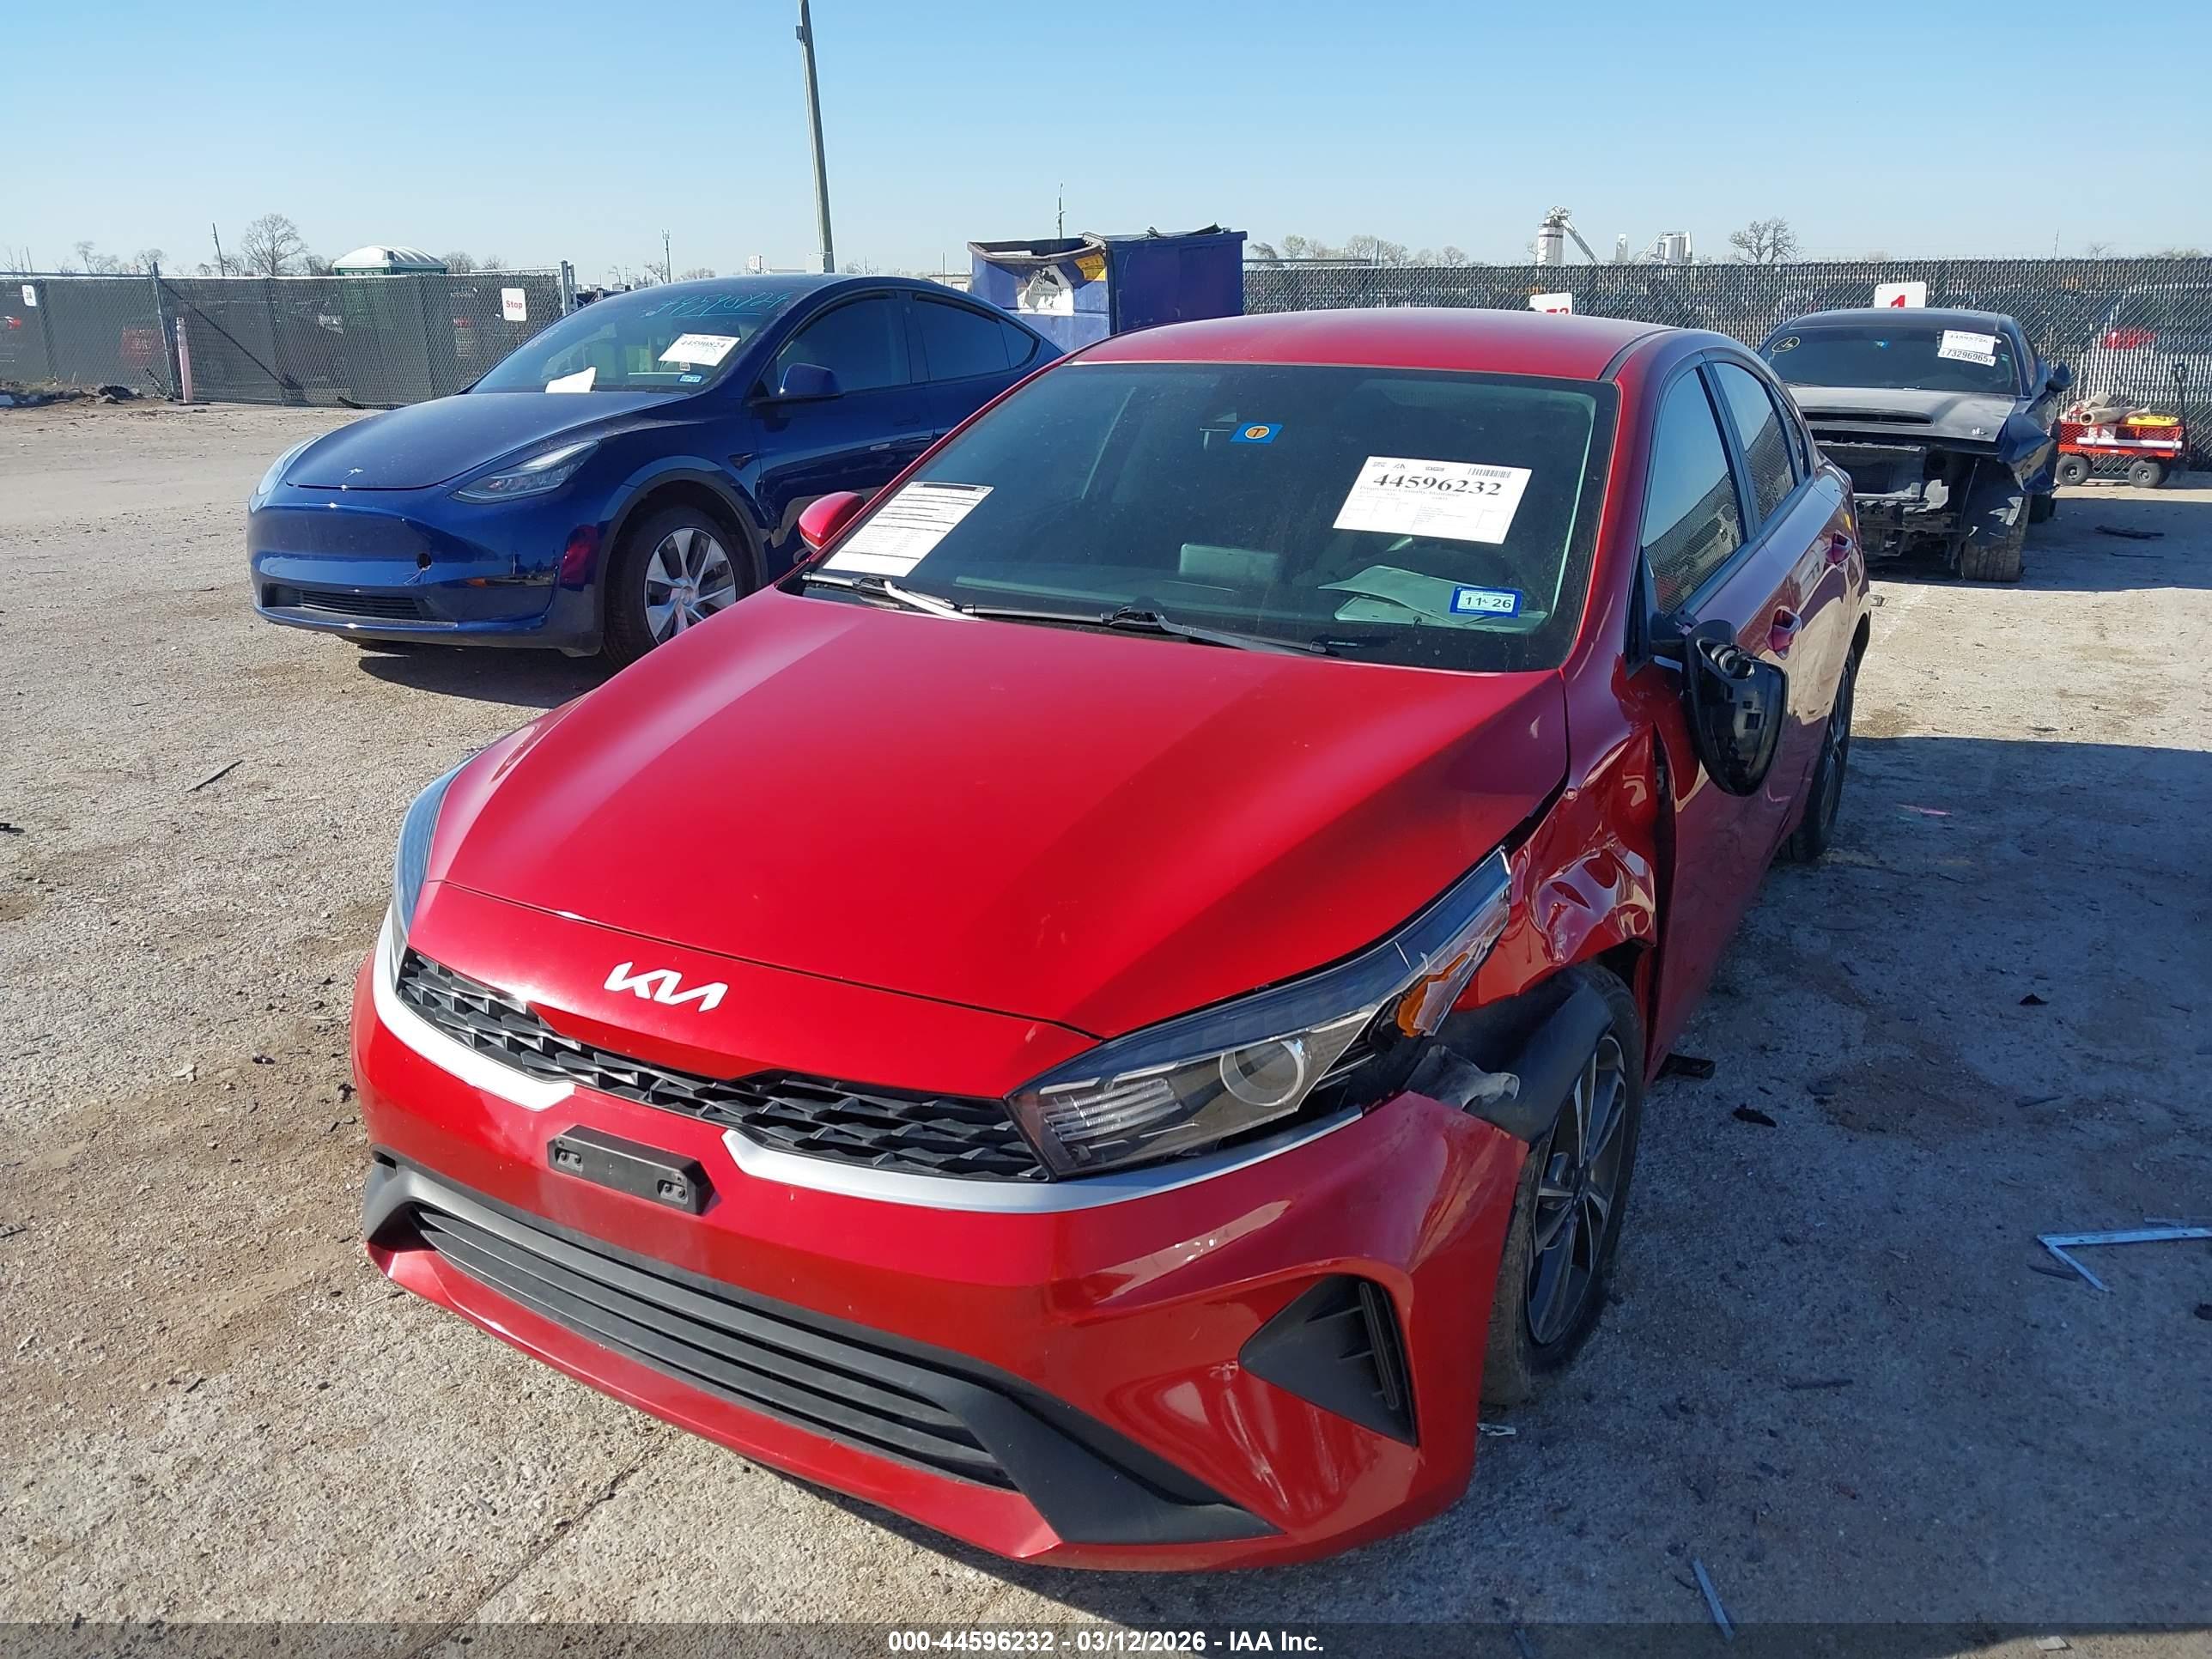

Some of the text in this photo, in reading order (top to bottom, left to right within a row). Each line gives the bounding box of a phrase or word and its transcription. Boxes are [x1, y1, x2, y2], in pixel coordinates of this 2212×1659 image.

[506, 300, 523, 310] Stop
[1373, 473, 1503, 496] 44596232
[1465, 596, 1482, 606] 11
[1492, 598, 1512, 609] 26
[604, 961, 728, 1012] KIA
